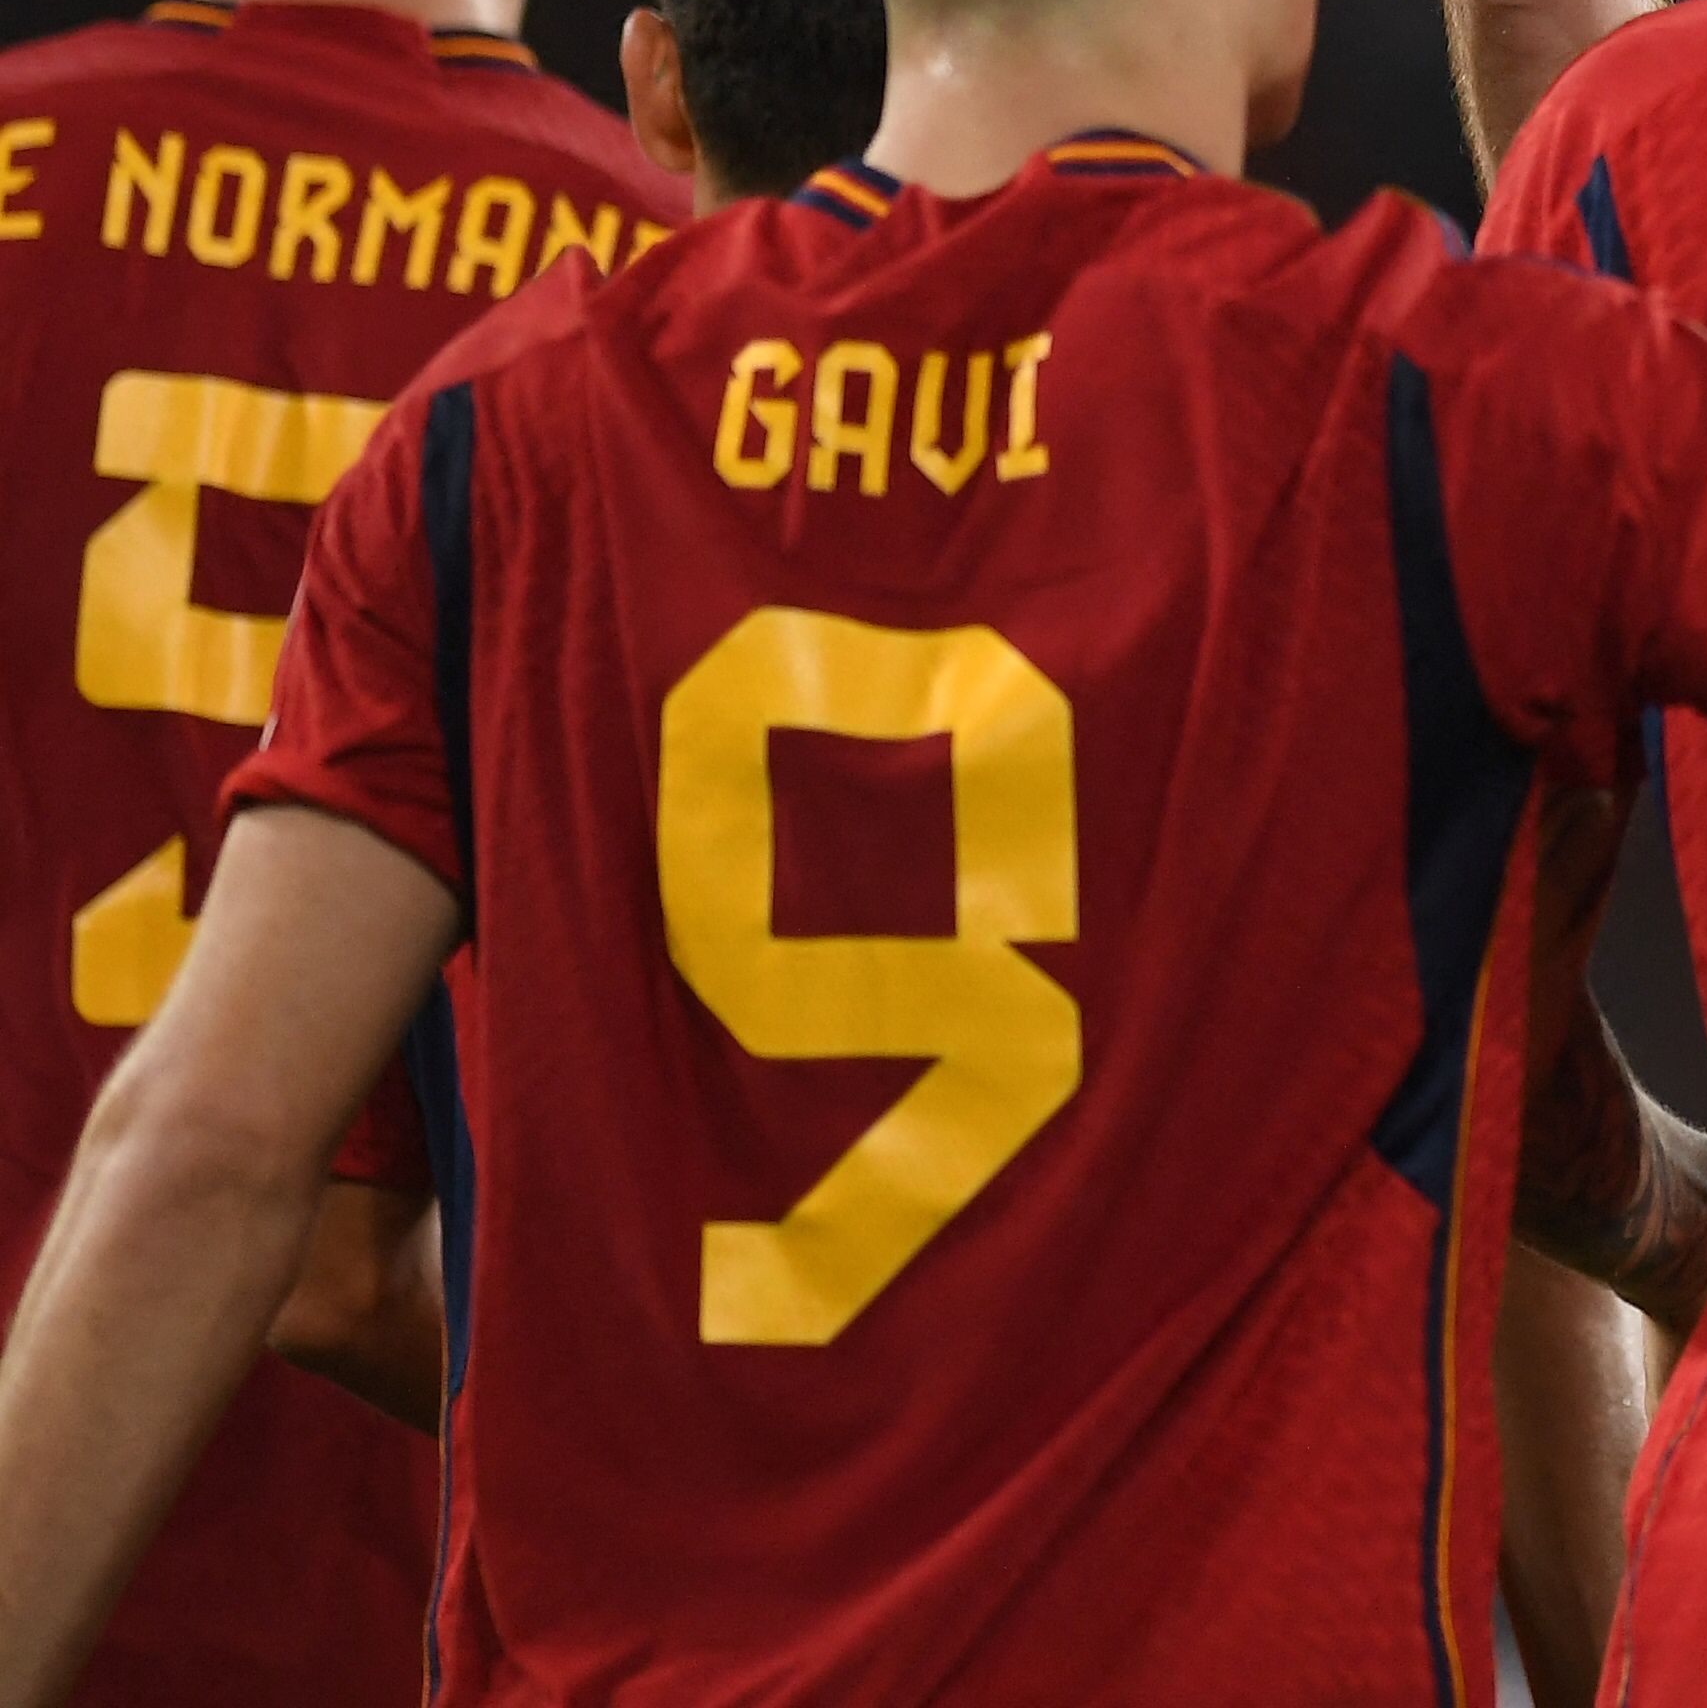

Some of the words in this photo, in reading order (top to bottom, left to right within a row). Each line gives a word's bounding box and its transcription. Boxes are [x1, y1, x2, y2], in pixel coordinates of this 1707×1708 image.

[101, 129, 677, 299] NORMAN
[712, 332, 1053, 497] GAVI
[655, 605, 1083, 1346] 9
